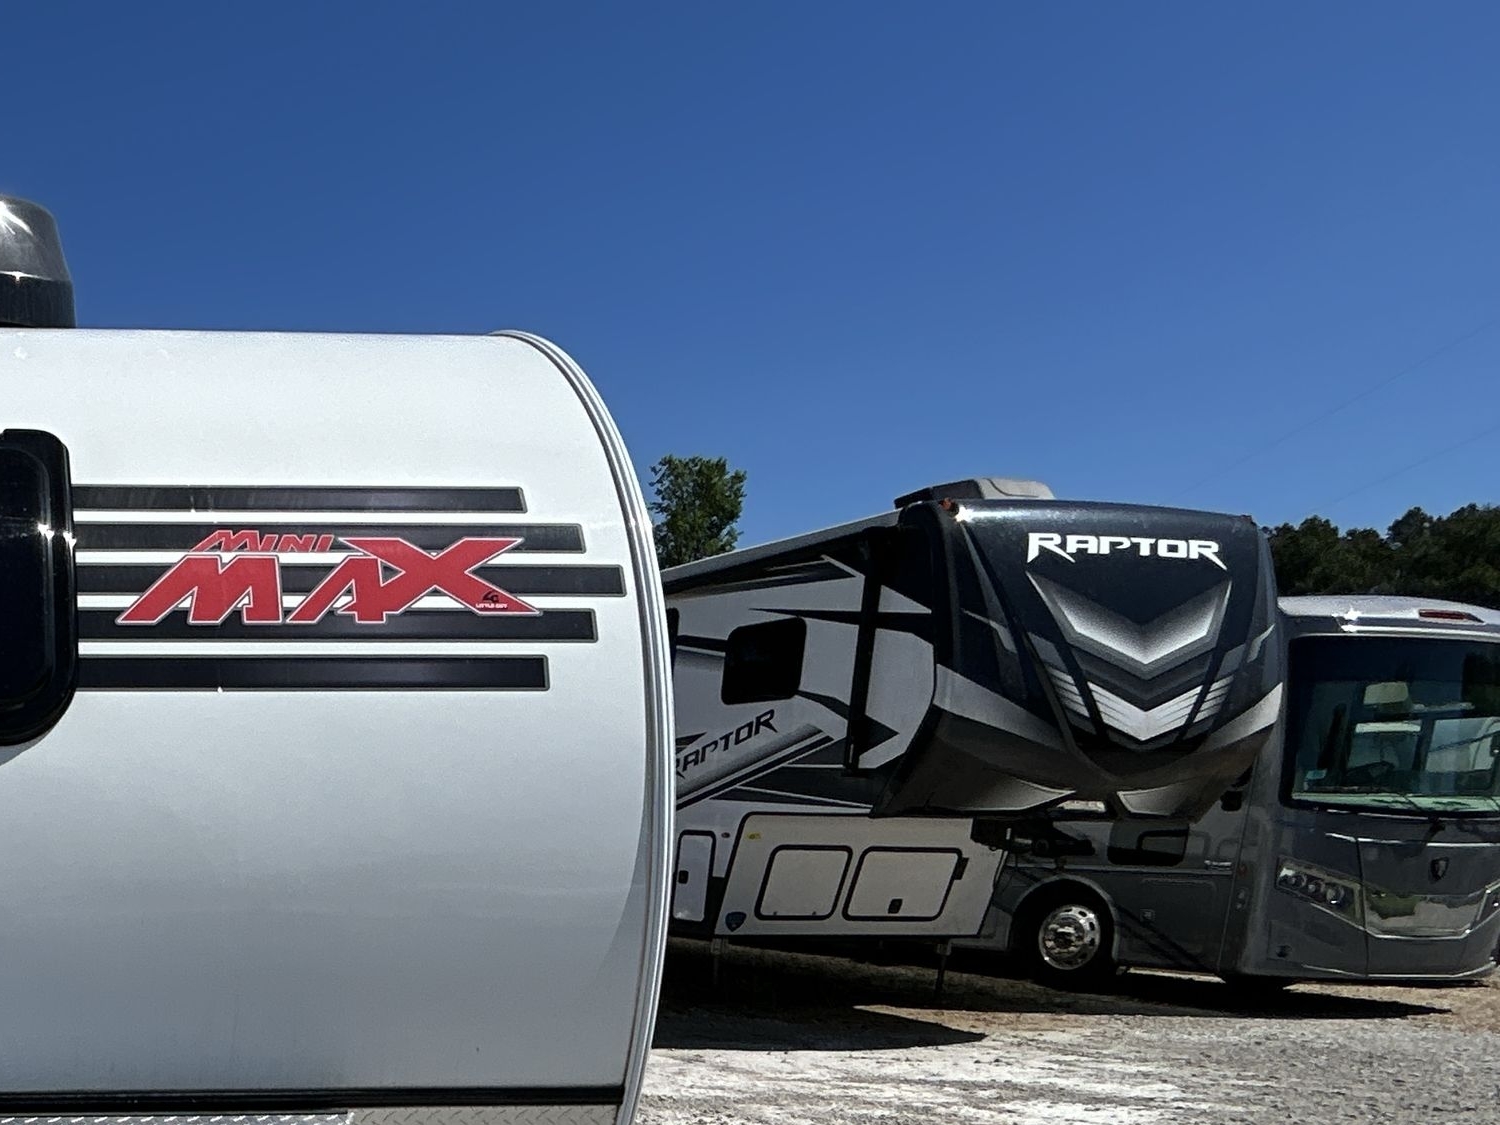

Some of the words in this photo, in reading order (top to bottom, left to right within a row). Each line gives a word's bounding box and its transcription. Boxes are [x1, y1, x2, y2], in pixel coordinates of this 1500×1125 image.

[189, 529, 335, 553] MINI
[1026, 531, 1229, 571] RAPTOR
[114, 536, 543, 625] MAX
